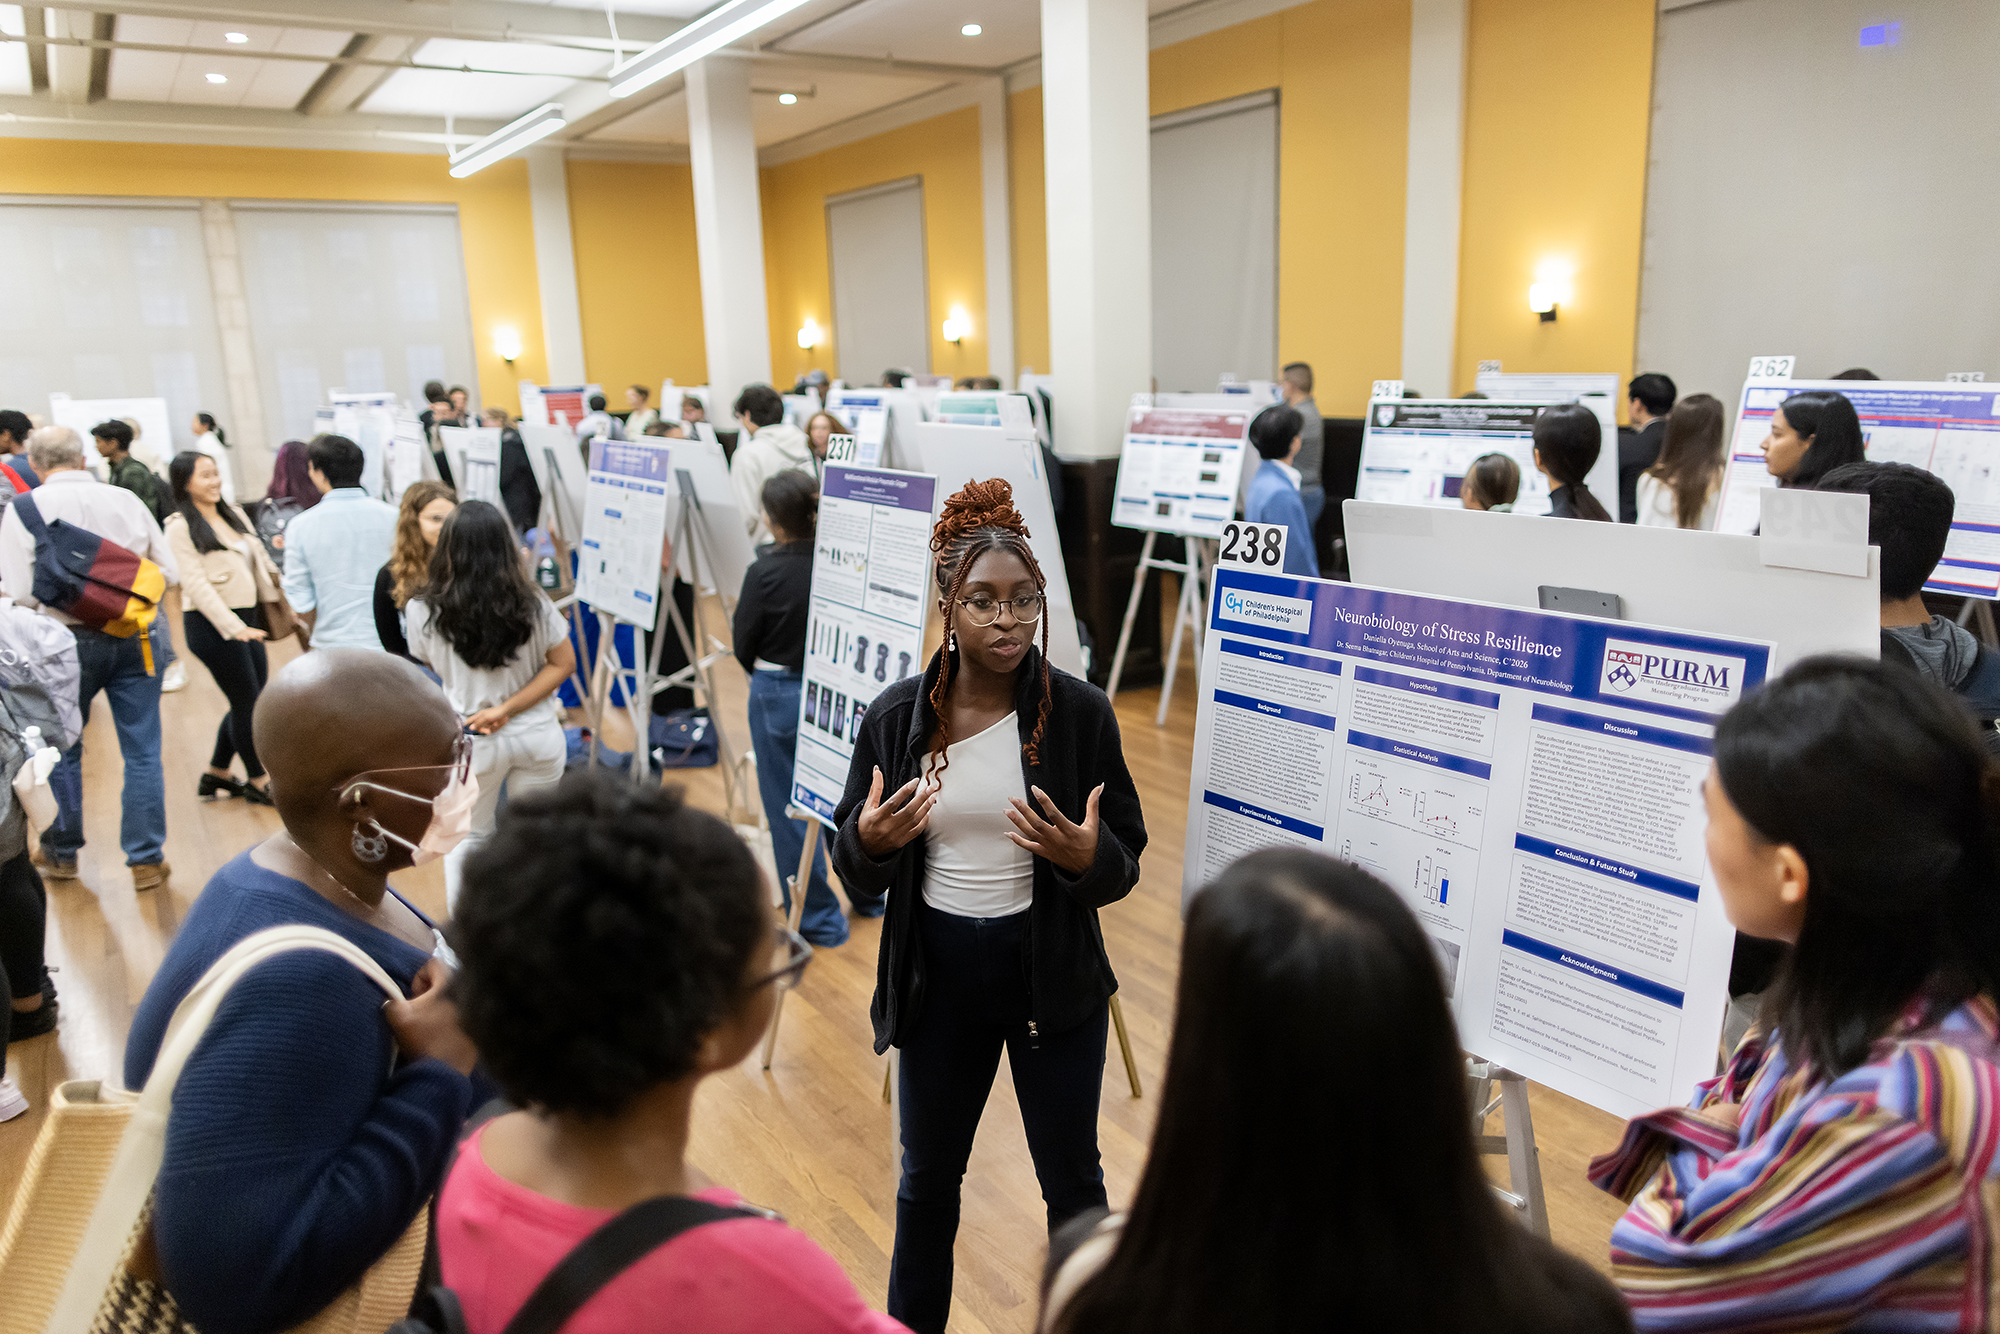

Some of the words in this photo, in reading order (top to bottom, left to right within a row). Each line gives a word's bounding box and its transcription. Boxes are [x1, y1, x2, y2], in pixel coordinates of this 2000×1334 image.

[1751, 360, 1789, 377] 262
[829, 437, 853, 460] 237
[1221, 524, 1282, 566] 238
[1246, 600, 1275, 612] Children's
[1276, 605, 1302, 616] Hospital
[1253, 610, 1290, 623] Philadelphia
[1335, 607, 1419, 637] Neurobiology
[1422, 622, 1439, 637] of
[1440, 624, 1480, 644] Stress
[1485, 631, 1562, 658] Resilience
[1258, 650, 1284, 661] Introduction
[1364, 633, 1386, 644] Daniella
[1388, 637, 1415, 650] Oyenuga,
[1417, 641, 1438, 653] School
[1439, 646, 1447, 654] of
[1447, 648, 1460, 657] Arts
[1461, 651, 1473, 659] and
[1474, 652, 1501, 665] Science,
[1336, 640, 1344, 648] Dr.
[1345, 642, 1361, 651] Seema
[1389, 650, 1416, 660] Children's
[1417, 655, 1439, 665] Hospital
[1440, 658, 1447, 666] of
[1447, 661, 1486, 675] Pennsylvania,
[1487, 668, 1522, 681] Department
[1531, 676, 1574, 692] Neurobiology
[1642, 654, 1730, 688] PURM
[1409, 681, 1438, 693] Hypothesis
[1651, 687, 1682, 699] Mentoring
[1683, 693, 1710, 702] Program
[1655, 680, 1700, 692] Undergraduate
[1701, 688, 1729, 697] Research
[1257, 702, 1281, 714] Background
[1604, 722, 1638, 736] Discussion
[1394, 745, 1416, 758] Statistical
[1418, 750, 1438, 763] Analysis
[1239, 805, 1267, 819] Experimental
[1267, 812, 1282, 825] Design
[1554, 848, 1588, 865] Conclusion
[1590, 857, 1596, 865] &
[1597, 860, 1617, 873] Future
[1619, 865, 1638, 879] Study
[1560, 954, 1618, 981] Acknowledgments
